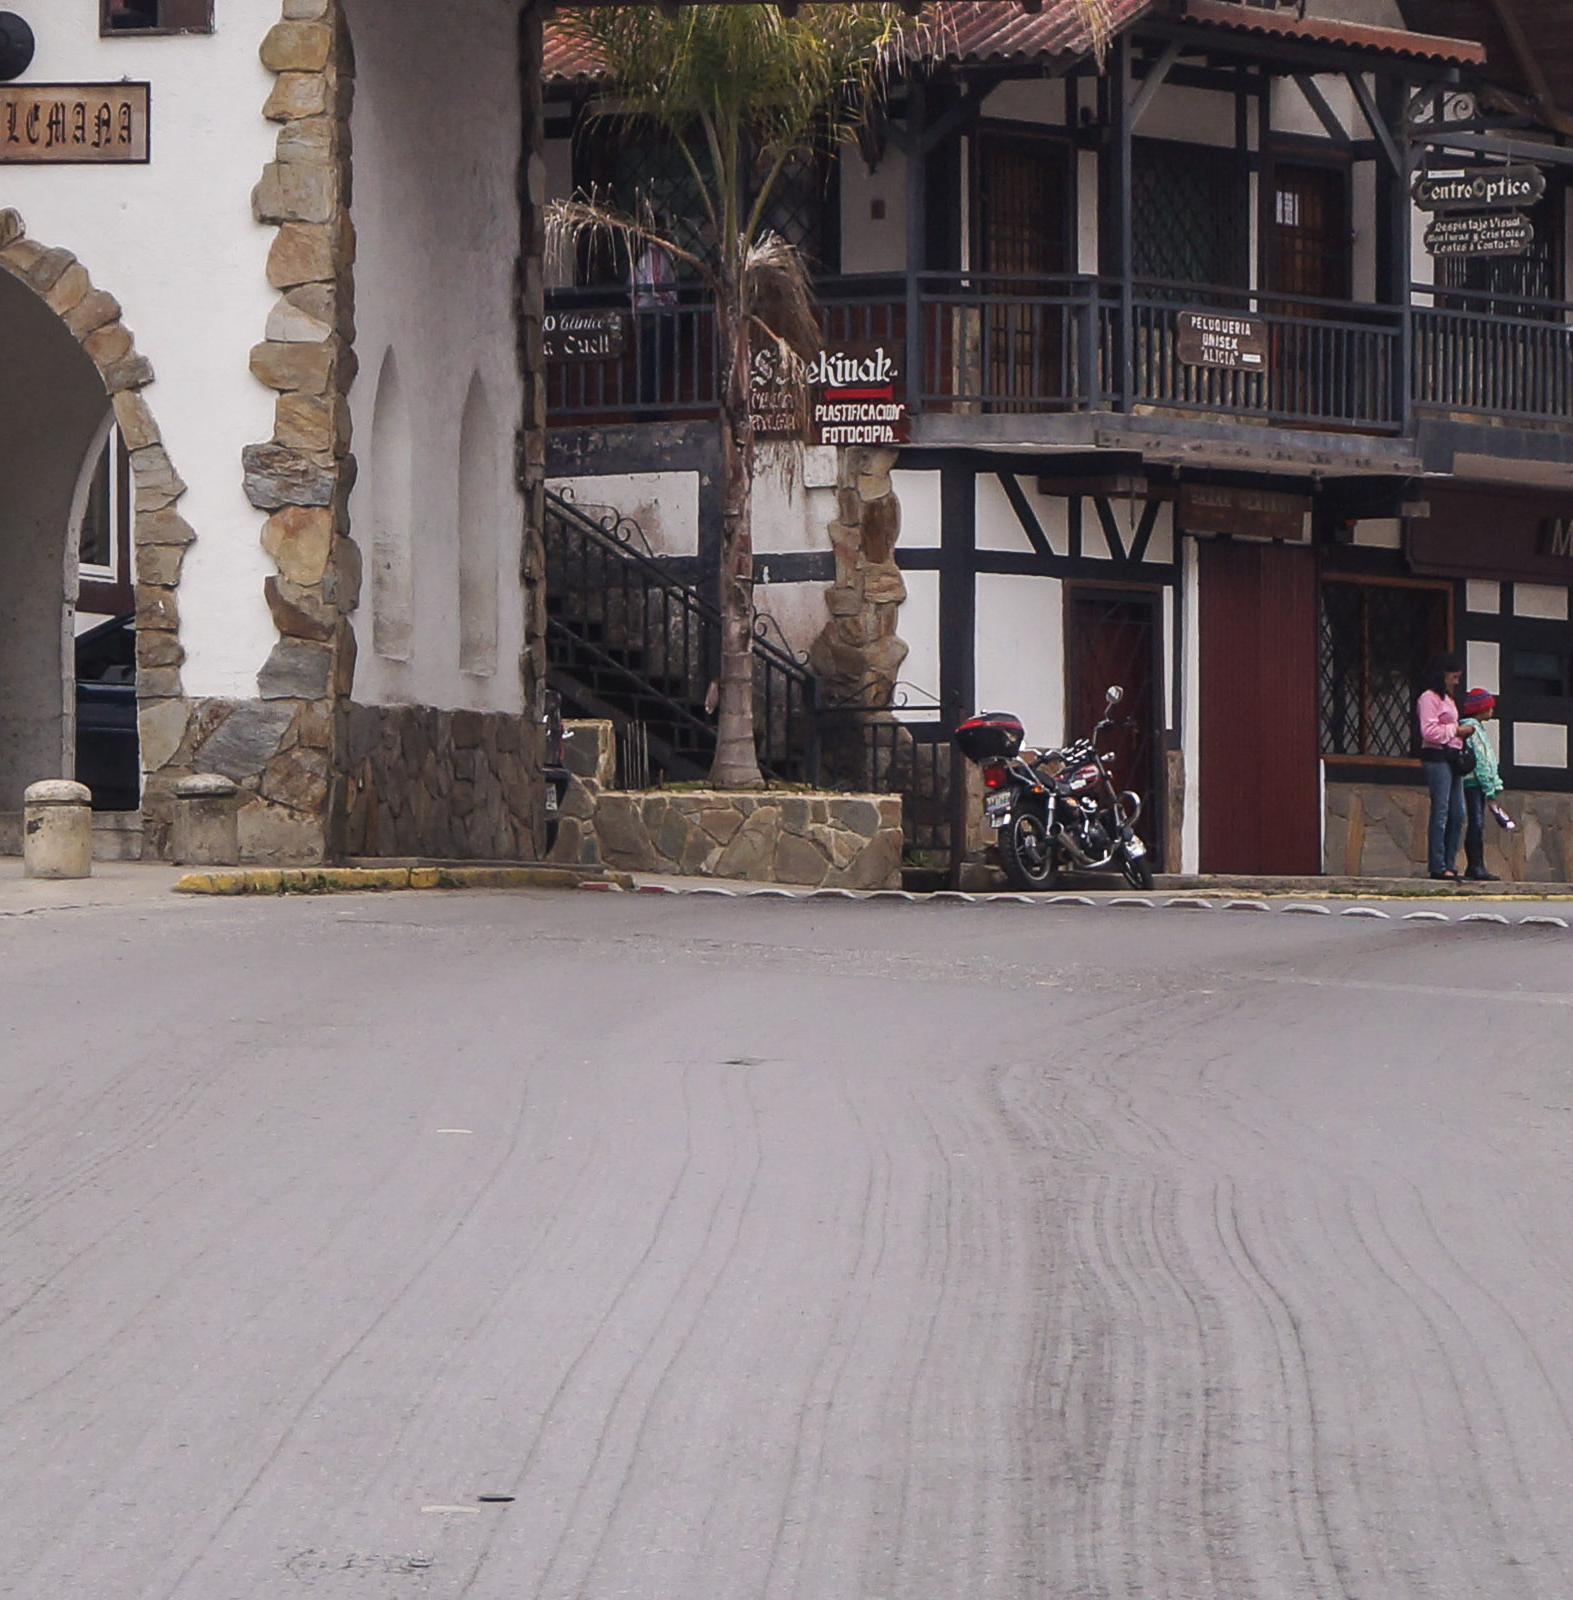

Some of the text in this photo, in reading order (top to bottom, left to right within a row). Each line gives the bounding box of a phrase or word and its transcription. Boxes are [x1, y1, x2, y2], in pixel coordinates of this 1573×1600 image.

[1190, 316, 1252, 336] PELUQUERIA
[1202, 333, 1239, 350] UNISEX
[814, 403, 906, 422] PLASTIFICACION
